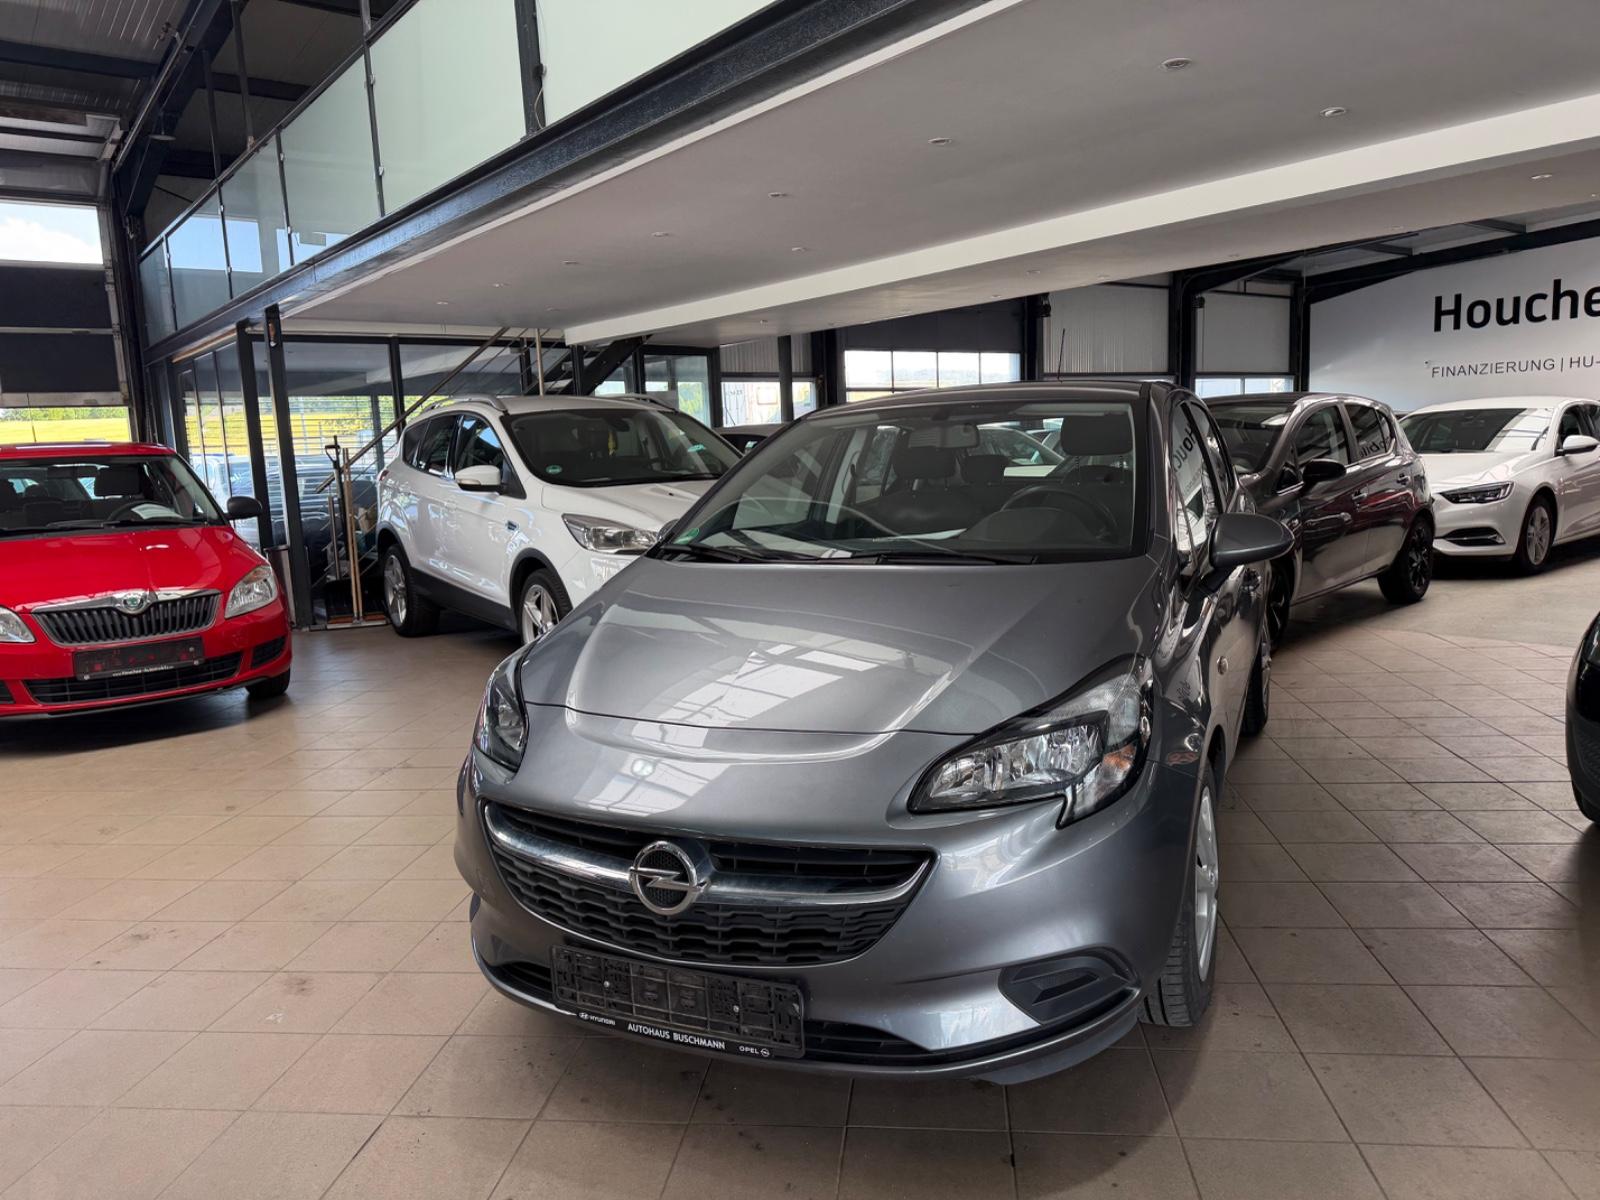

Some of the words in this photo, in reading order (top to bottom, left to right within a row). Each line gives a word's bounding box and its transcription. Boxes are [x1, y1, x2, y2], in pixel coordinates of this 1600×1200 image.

[1431, 358, 1555, 378] FINANZIERUNG
[627, 1023, 670, 1039] AUTOHAUS
[673, 1032, 726, 1050] BUSCHMANN
[739, 1045, 759, 1054] OPEL
